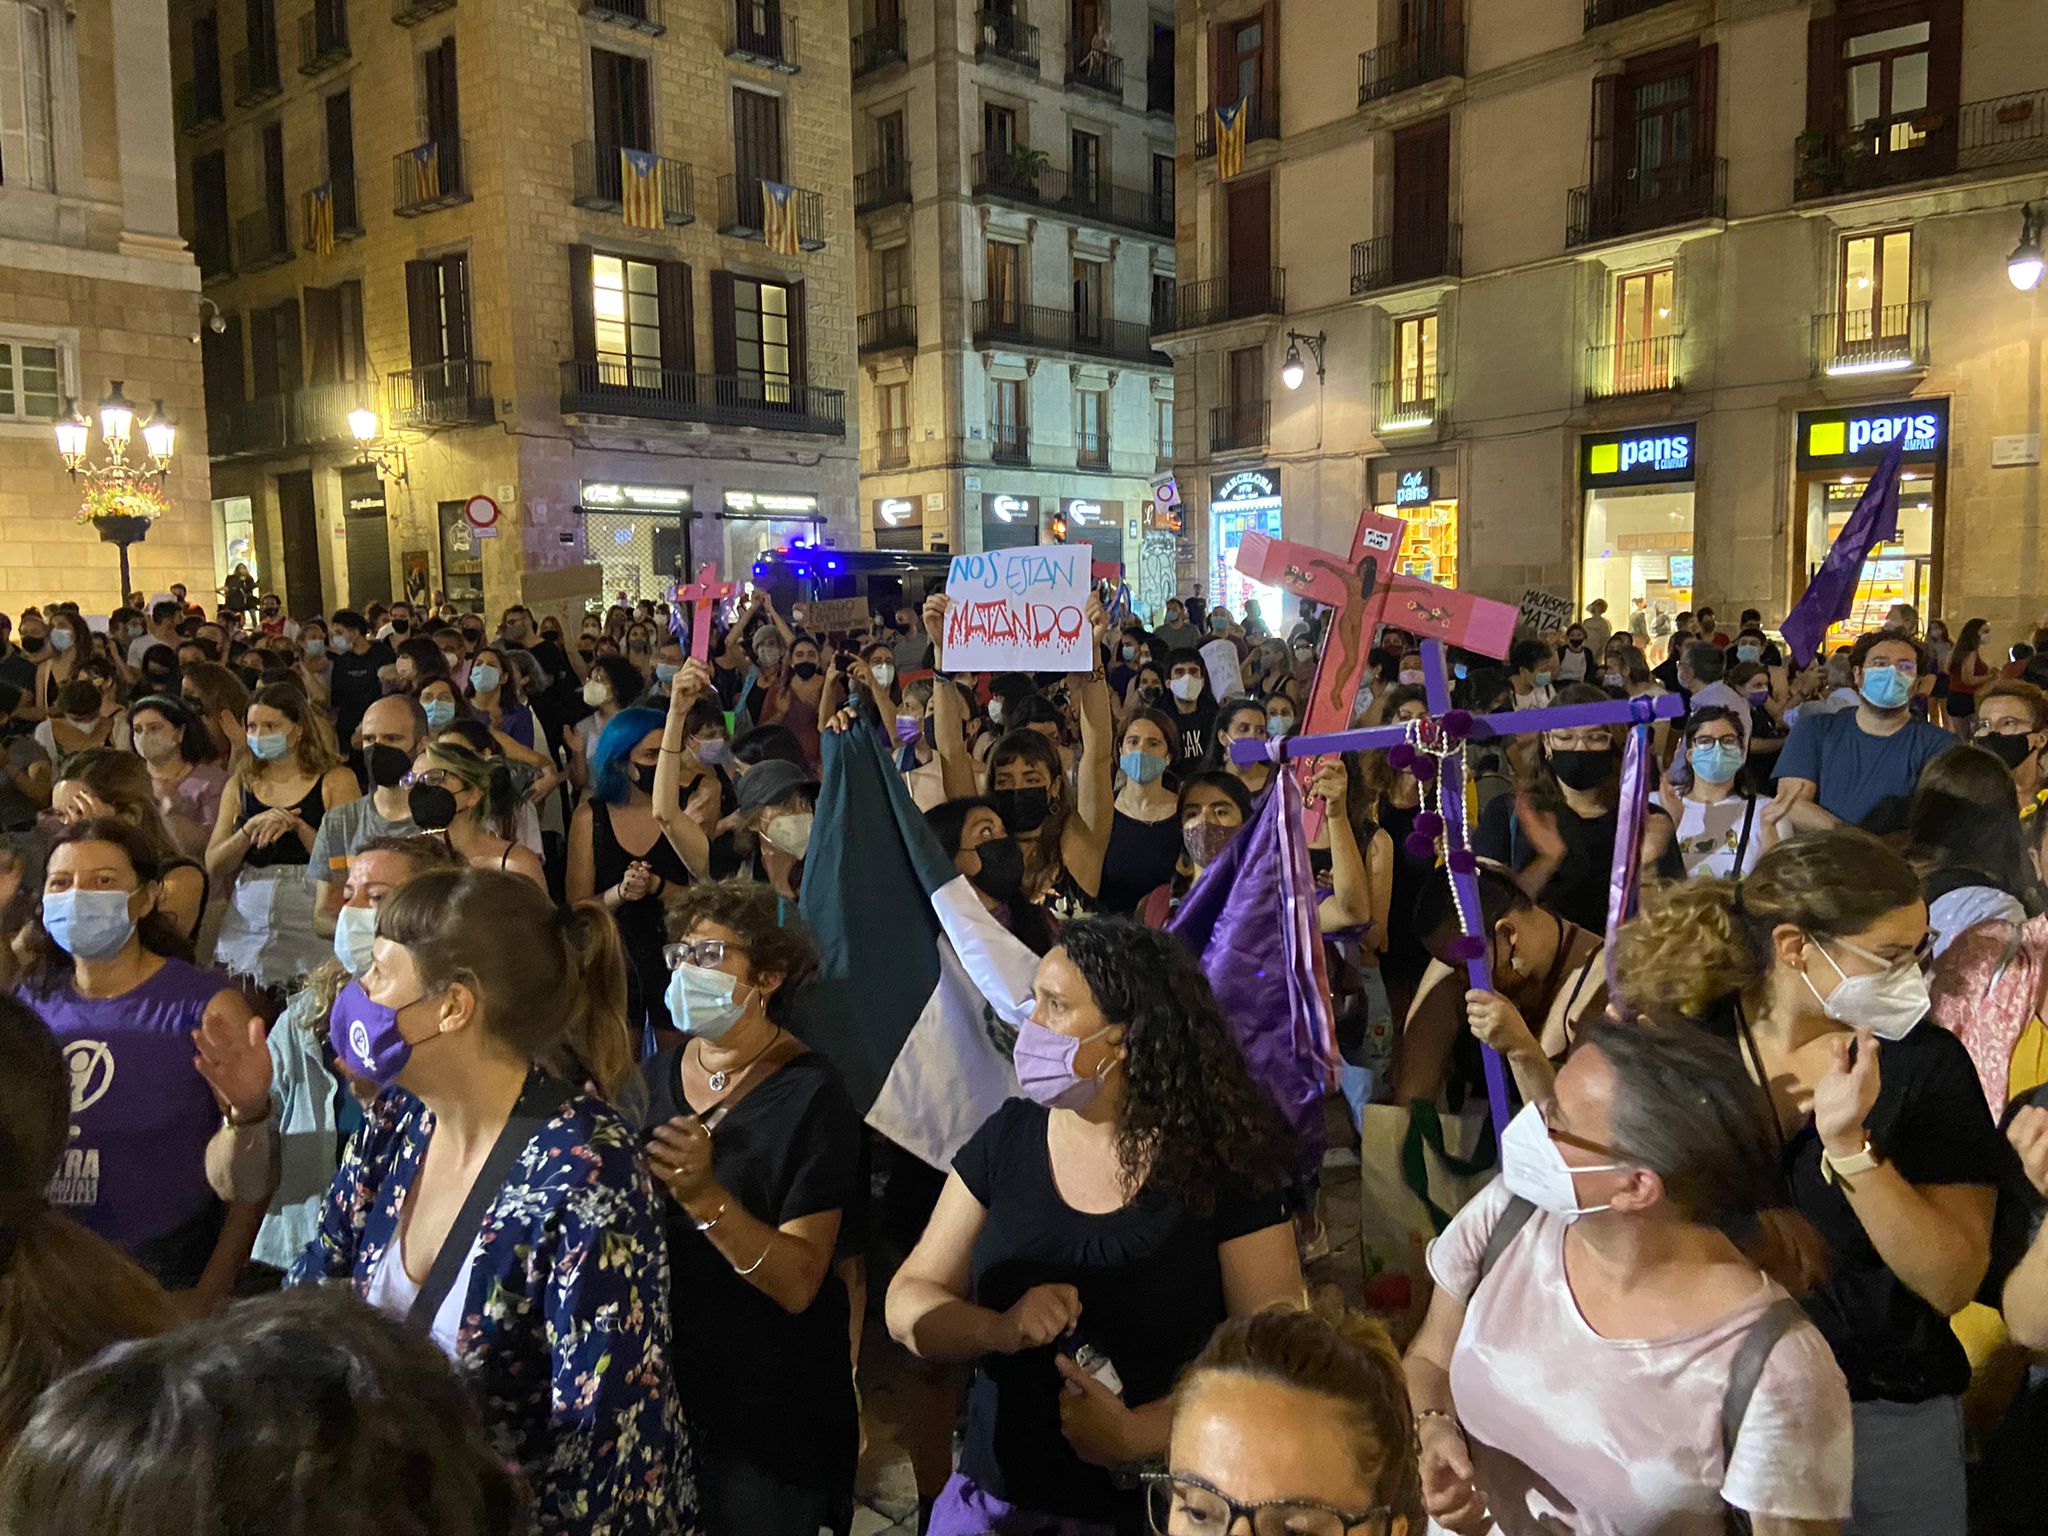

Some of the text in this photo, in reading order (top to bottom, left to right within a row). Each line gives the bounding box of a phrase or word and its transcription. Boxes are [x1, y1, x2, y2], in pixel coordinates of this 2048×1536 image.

[1621, 436, 1689, 472] pans
[1219, 472, 1273, 499] BARCELONA
[1396, 486, 1429, 506] pans
[950, 551, 1075, 596] NOS ESTAN
[1522, 589, 1575, 616] MACHISMO
[948, 599, 1083, 650] MATANDO
[1520, 605, 1562, 632] MATA
